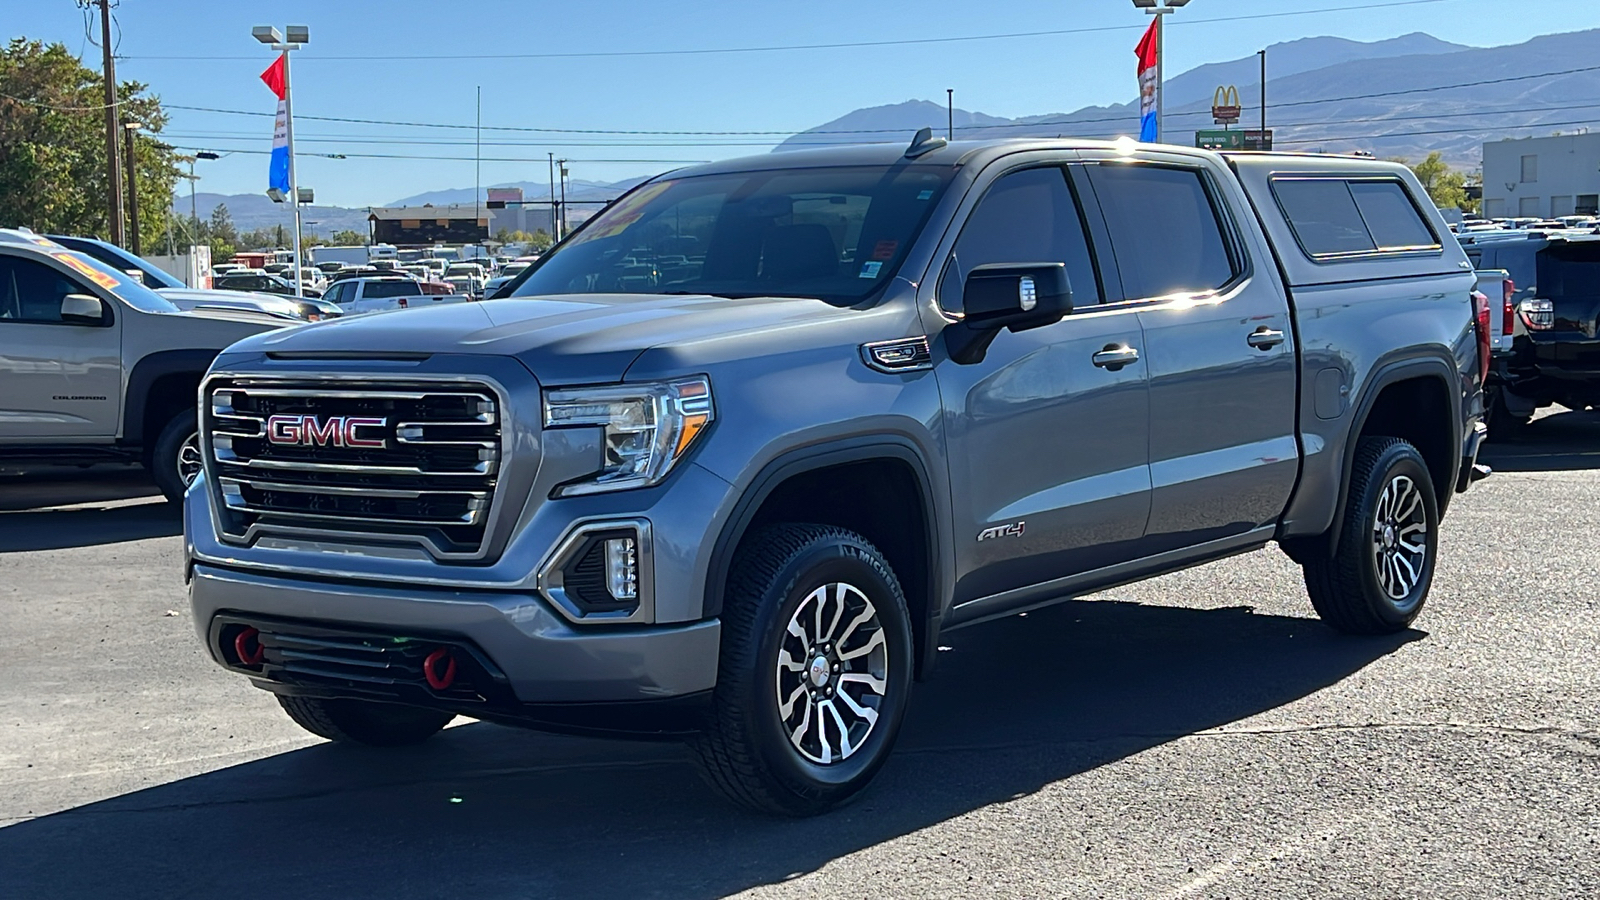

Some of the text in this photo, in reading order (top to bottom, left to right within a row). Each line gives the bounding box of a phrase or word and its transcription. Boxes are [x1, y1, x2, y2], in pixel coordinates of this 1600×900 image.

[267, 414, 387, 449] GMC
[977, 521, 1026, 542] AT4
[859, 550, 905, 611] MICHELIN
